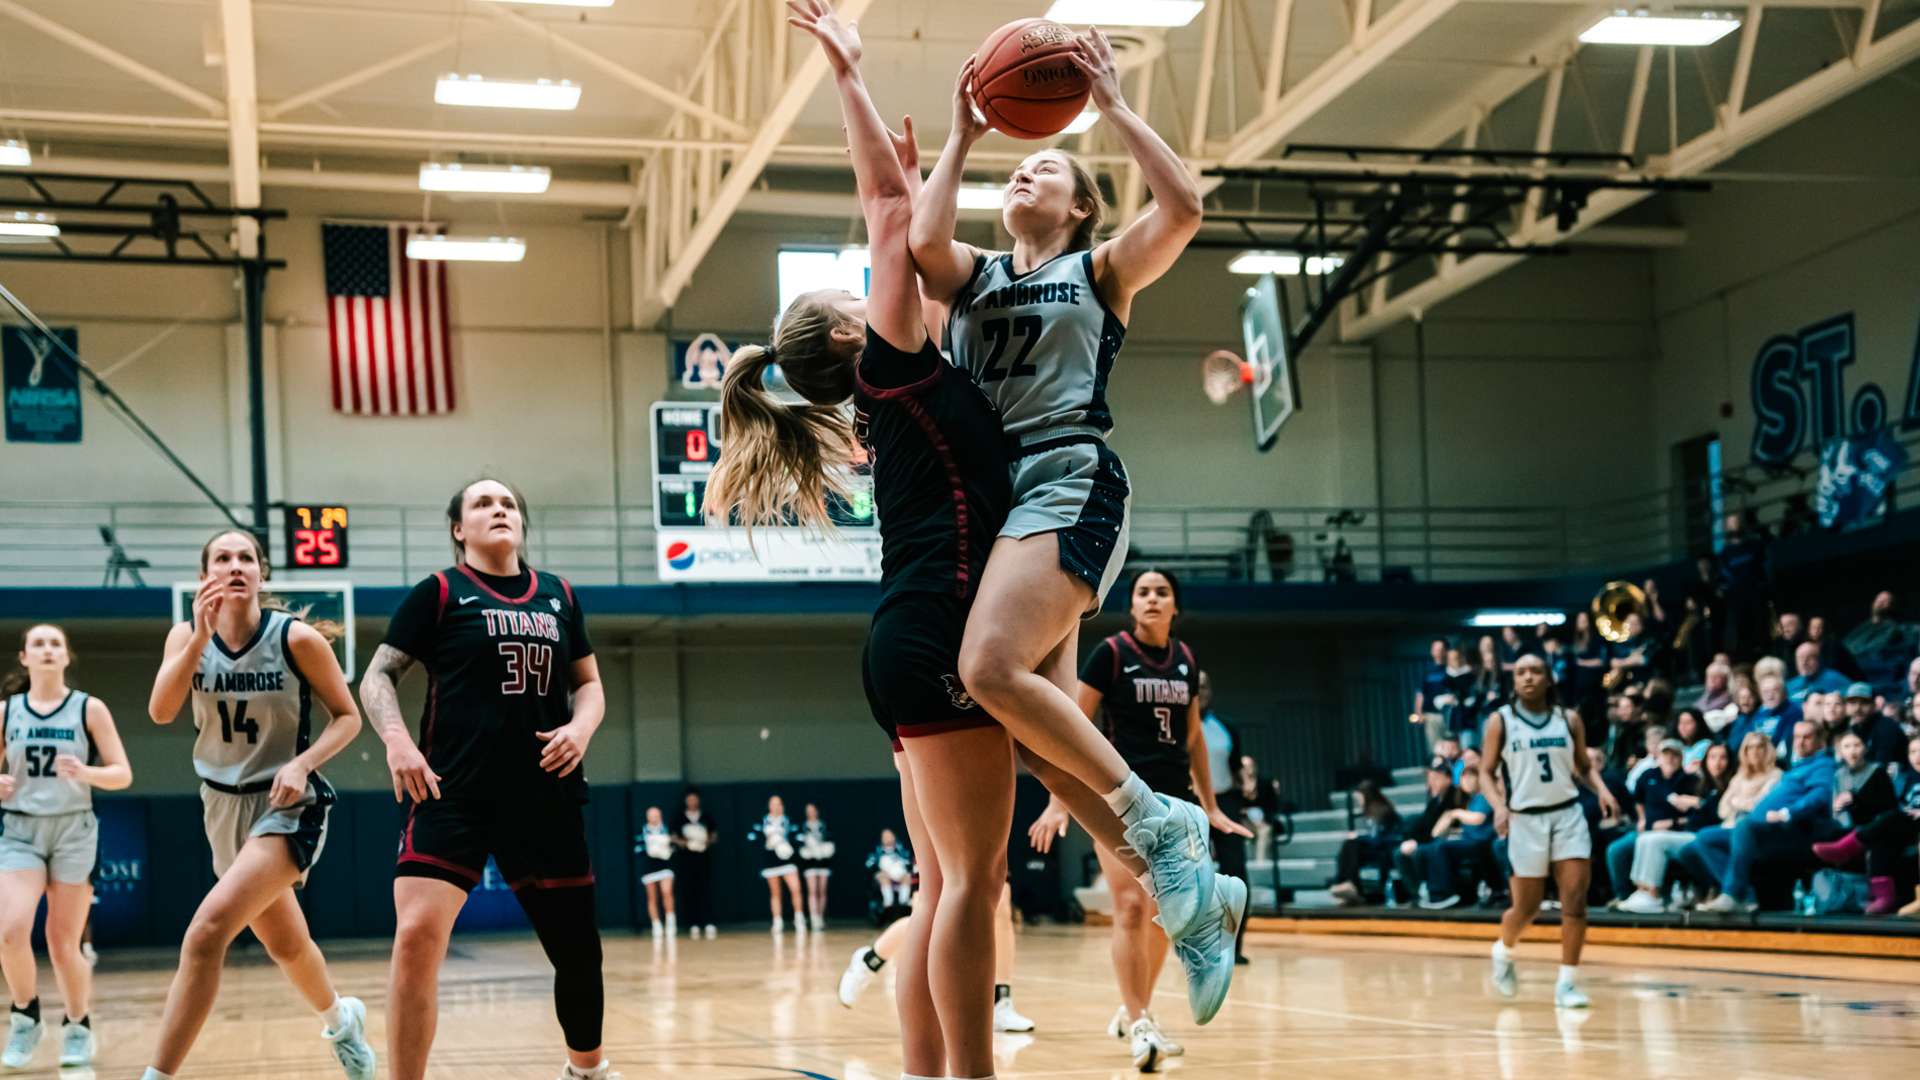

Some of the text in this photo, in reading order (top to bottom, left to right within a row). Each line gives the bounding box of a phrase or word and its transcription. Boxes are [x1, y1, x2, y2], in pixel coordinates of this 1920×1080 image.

[985, 282, 1080, 310] AMBROSE
[981, 314, 1042, 383] 22
[686, 430, 708, 461] 0
[295, 529, 340, 565] 25
[481, 609, 559, 642] TITANS
[214, 671, 283, 692] AMBROSE
[498, 642, 552, 696] 34
[1133, 678, 1190, 705] TITANS
[217, 700, 259, 744] 14
[25, 745, 57, 777] 52
[1537, 753, 1553, 783] 3
